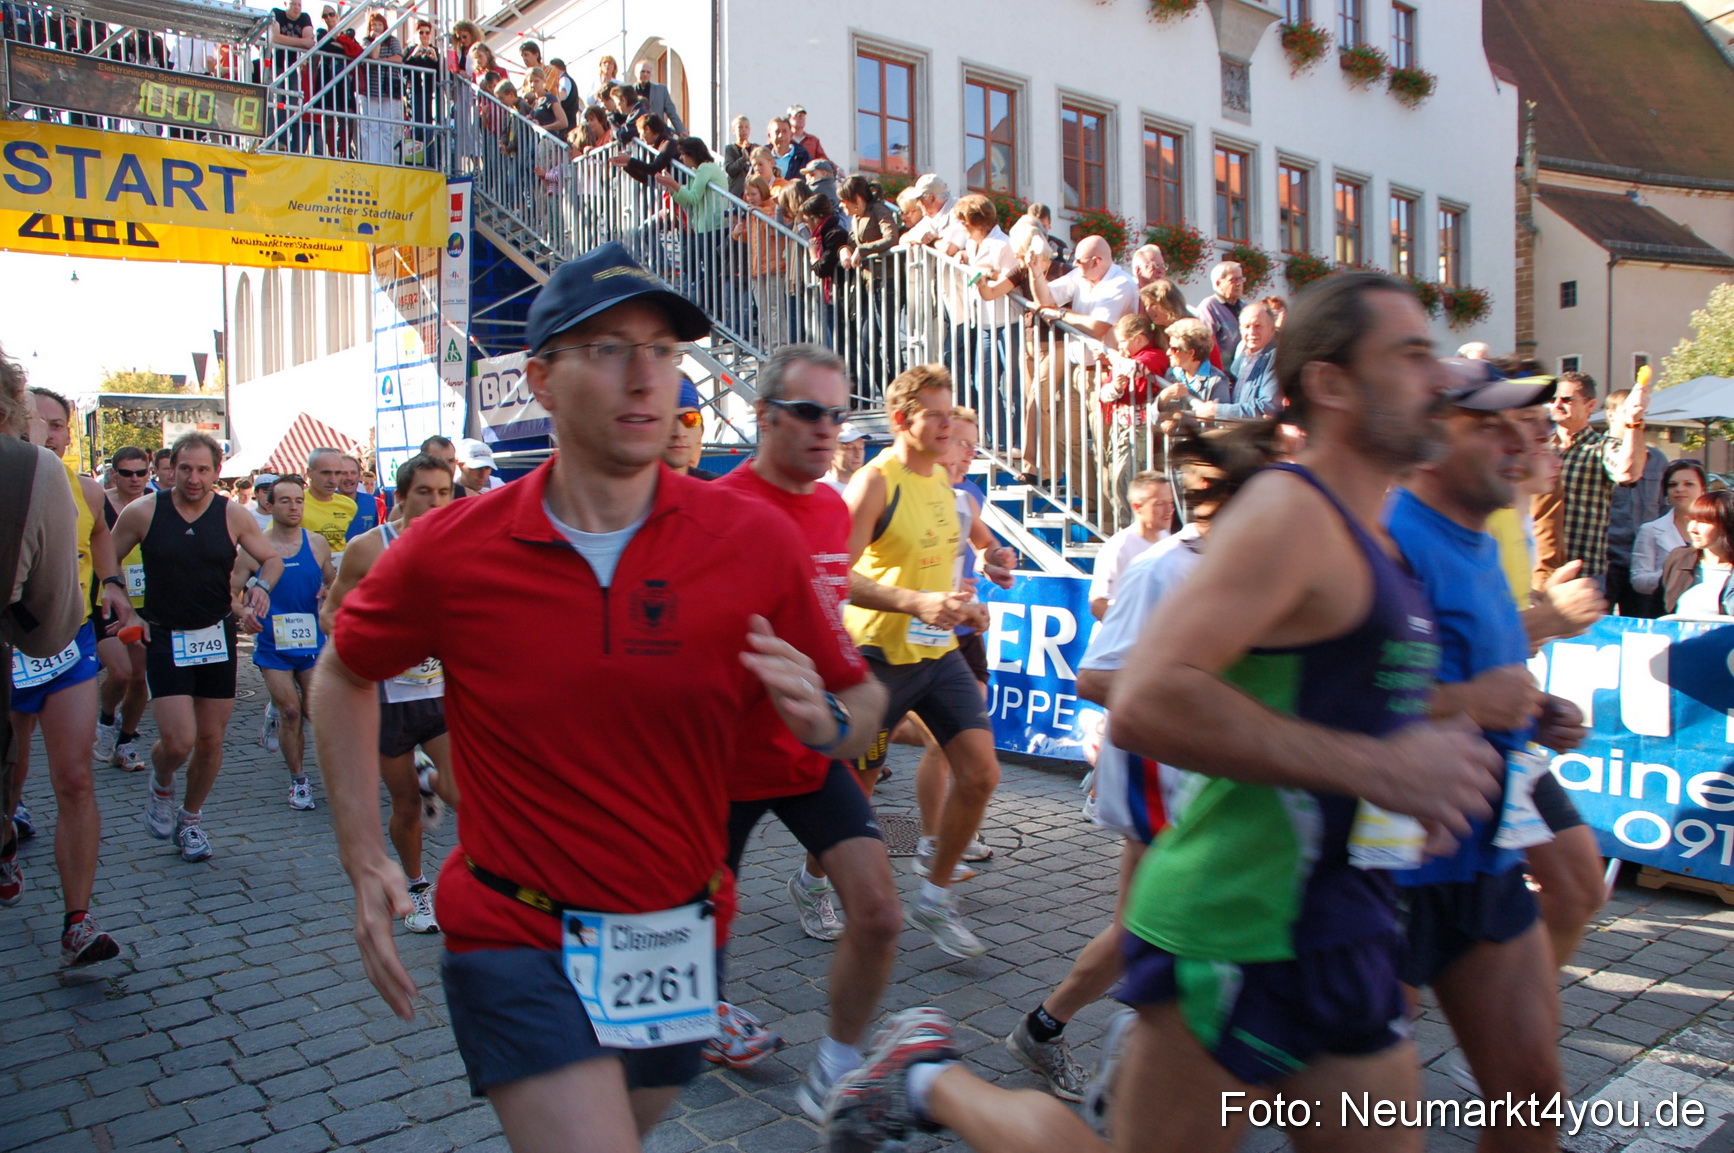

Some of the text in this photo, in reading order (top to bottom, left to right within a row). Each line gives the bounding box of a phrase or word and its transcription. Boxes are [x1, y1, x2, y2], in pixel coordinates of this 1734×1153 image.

[15, 46, 77, 66] SPORTRONIC
[98, 62, 257, 96] Elektronische Sportstätteneinrichtungen
[2, 140, 247, 214] START
[288, 200, 414, 221] Neumarkter Stadtlauf
[291, 628, 311, 639] 523
[189, 639, 222, 654] 3749
[30, 649, 75, 672] 3415
[610, 924, 692, 951] Clemens
[613, 961, 699, 1008] 2261
